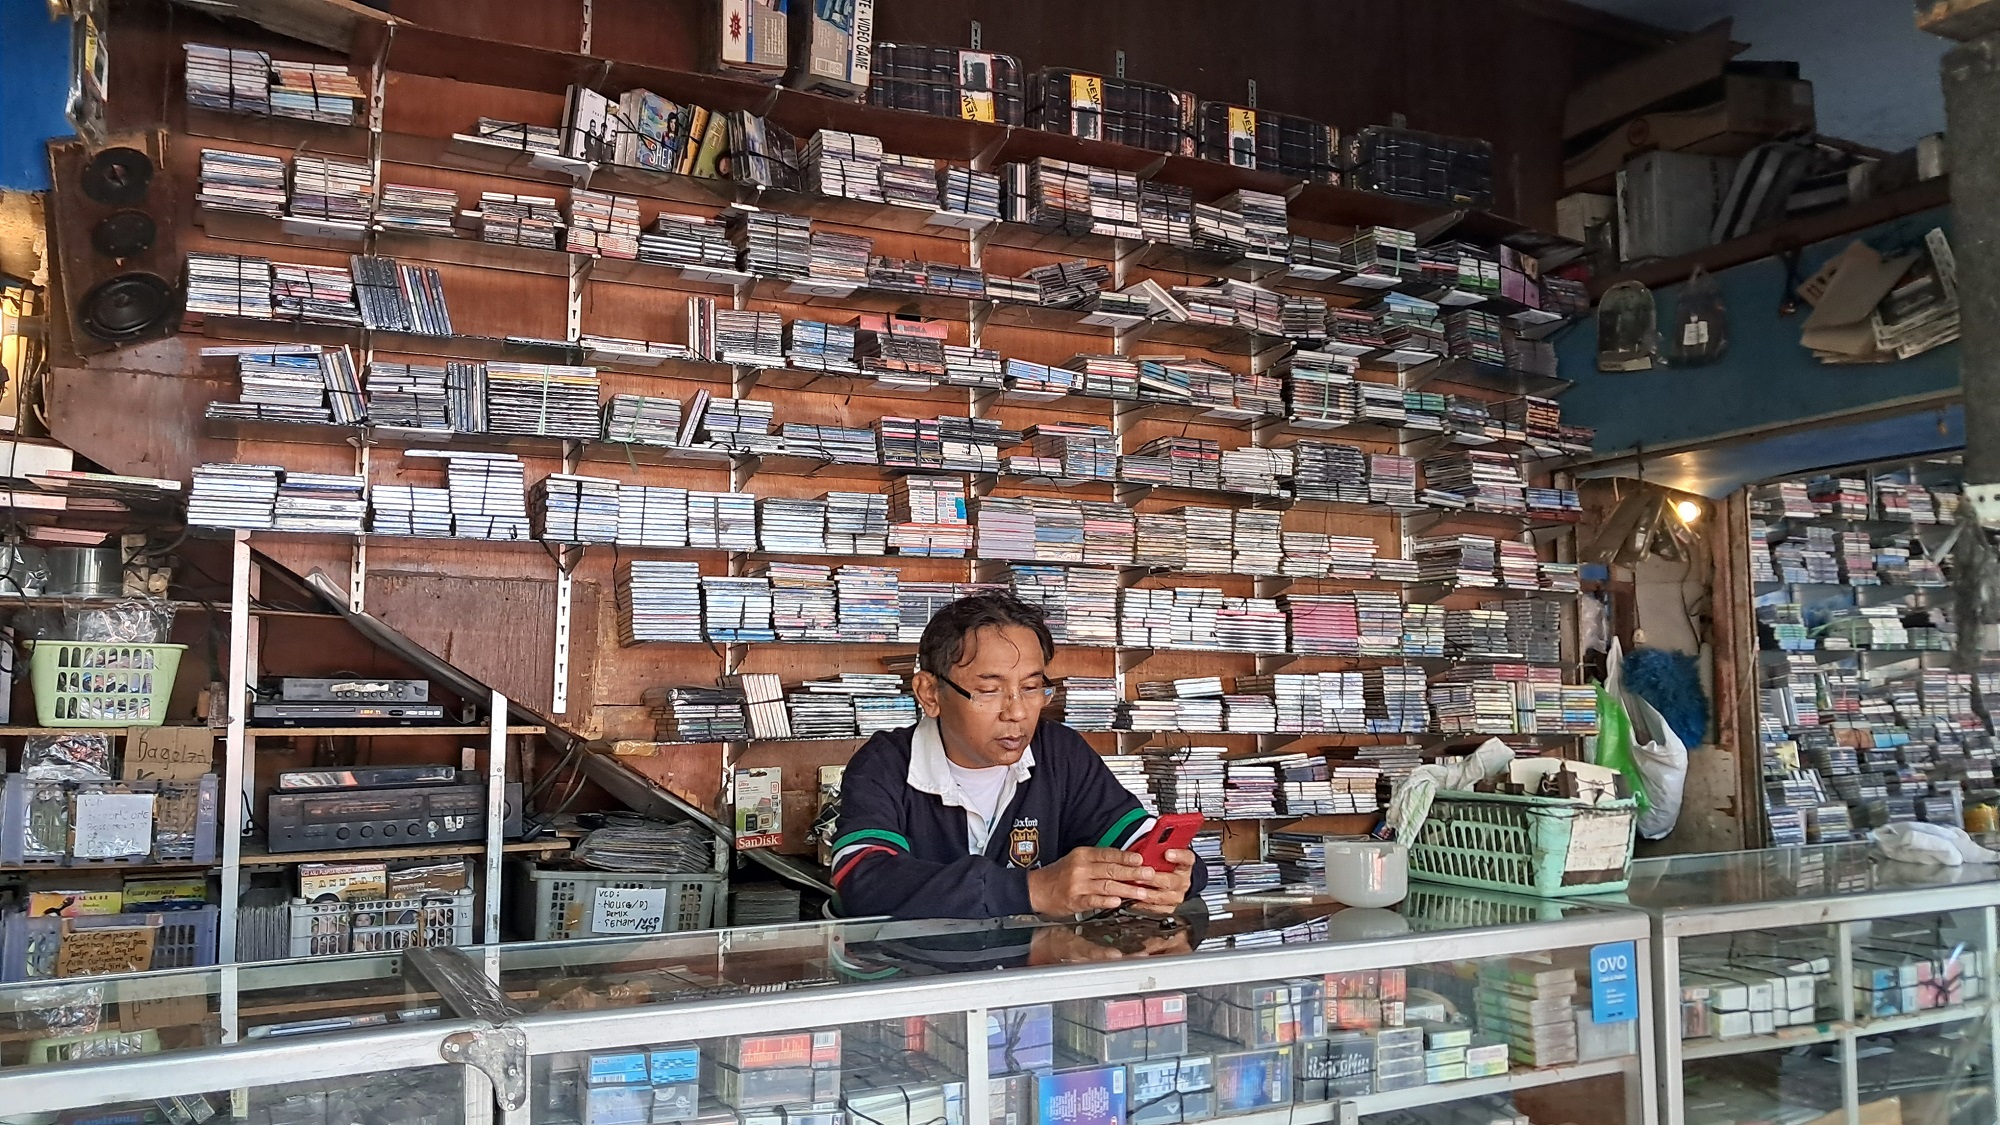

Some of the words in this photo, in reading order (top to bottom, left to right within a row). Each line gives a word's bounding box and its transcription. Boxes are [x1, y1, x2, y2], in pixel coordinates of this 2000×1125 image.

[857, 17, 871, 43] VIDEO
[855, 44, 870, 70] GAME
[1087, 78, 1101, 106] NEW
[1243, 111, 1255, 136] NEW
[1012, 816, 1038, 827] Oxford
[739, 835, 778, 848] SanDisk
[318, 877, 368, 889] ANEKA
[599, 890, 620, 898] VCD:
[1597, 955, 1628, 973] OVO
